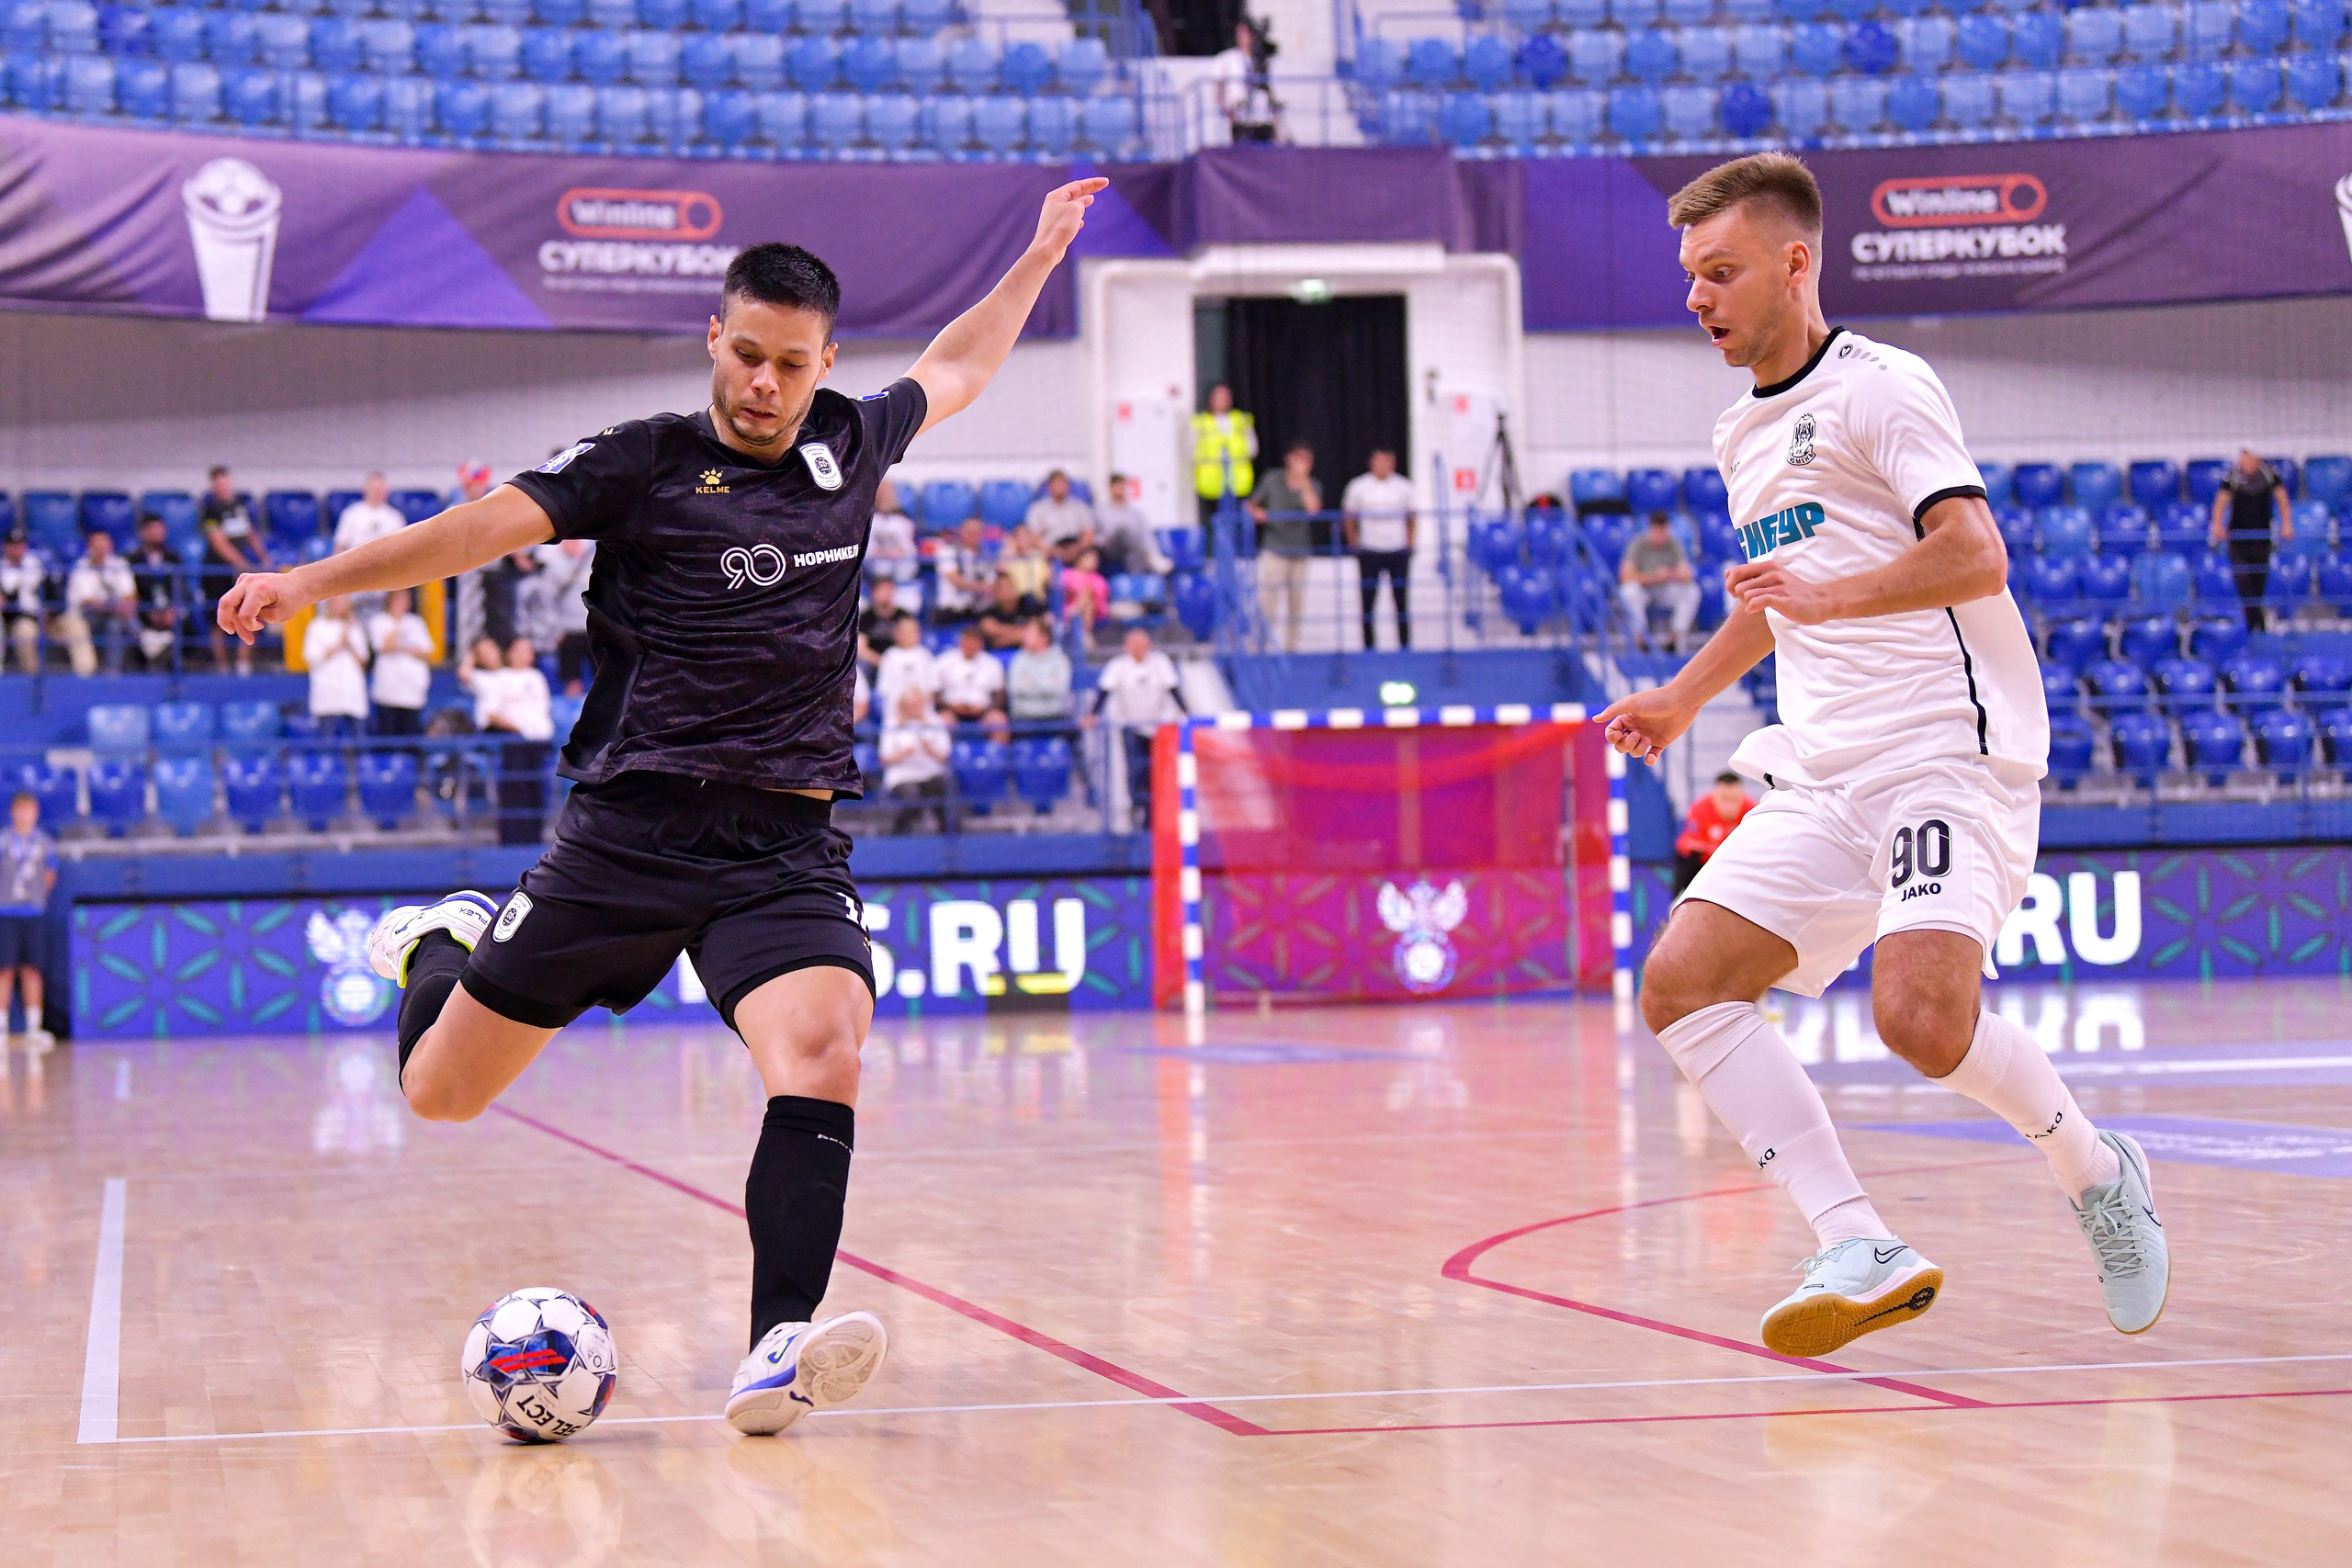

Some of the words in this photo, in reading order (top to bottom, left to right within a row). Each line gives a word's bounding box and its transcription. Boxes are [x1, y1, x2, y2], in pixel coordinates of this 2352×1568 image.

[1850, 223, 2067, 264] СУПЕРКУБОК
[695, 486, 730, 494] KELME
[720, 543, 786, 590] 90
[793, 543, 859, 568] НОРНИКЕЛ
[1891, 818, 1953, 889] 90
[1901, 883, 1942, 902] JAKO
[516, 1394, 582, 1437] SELECT
